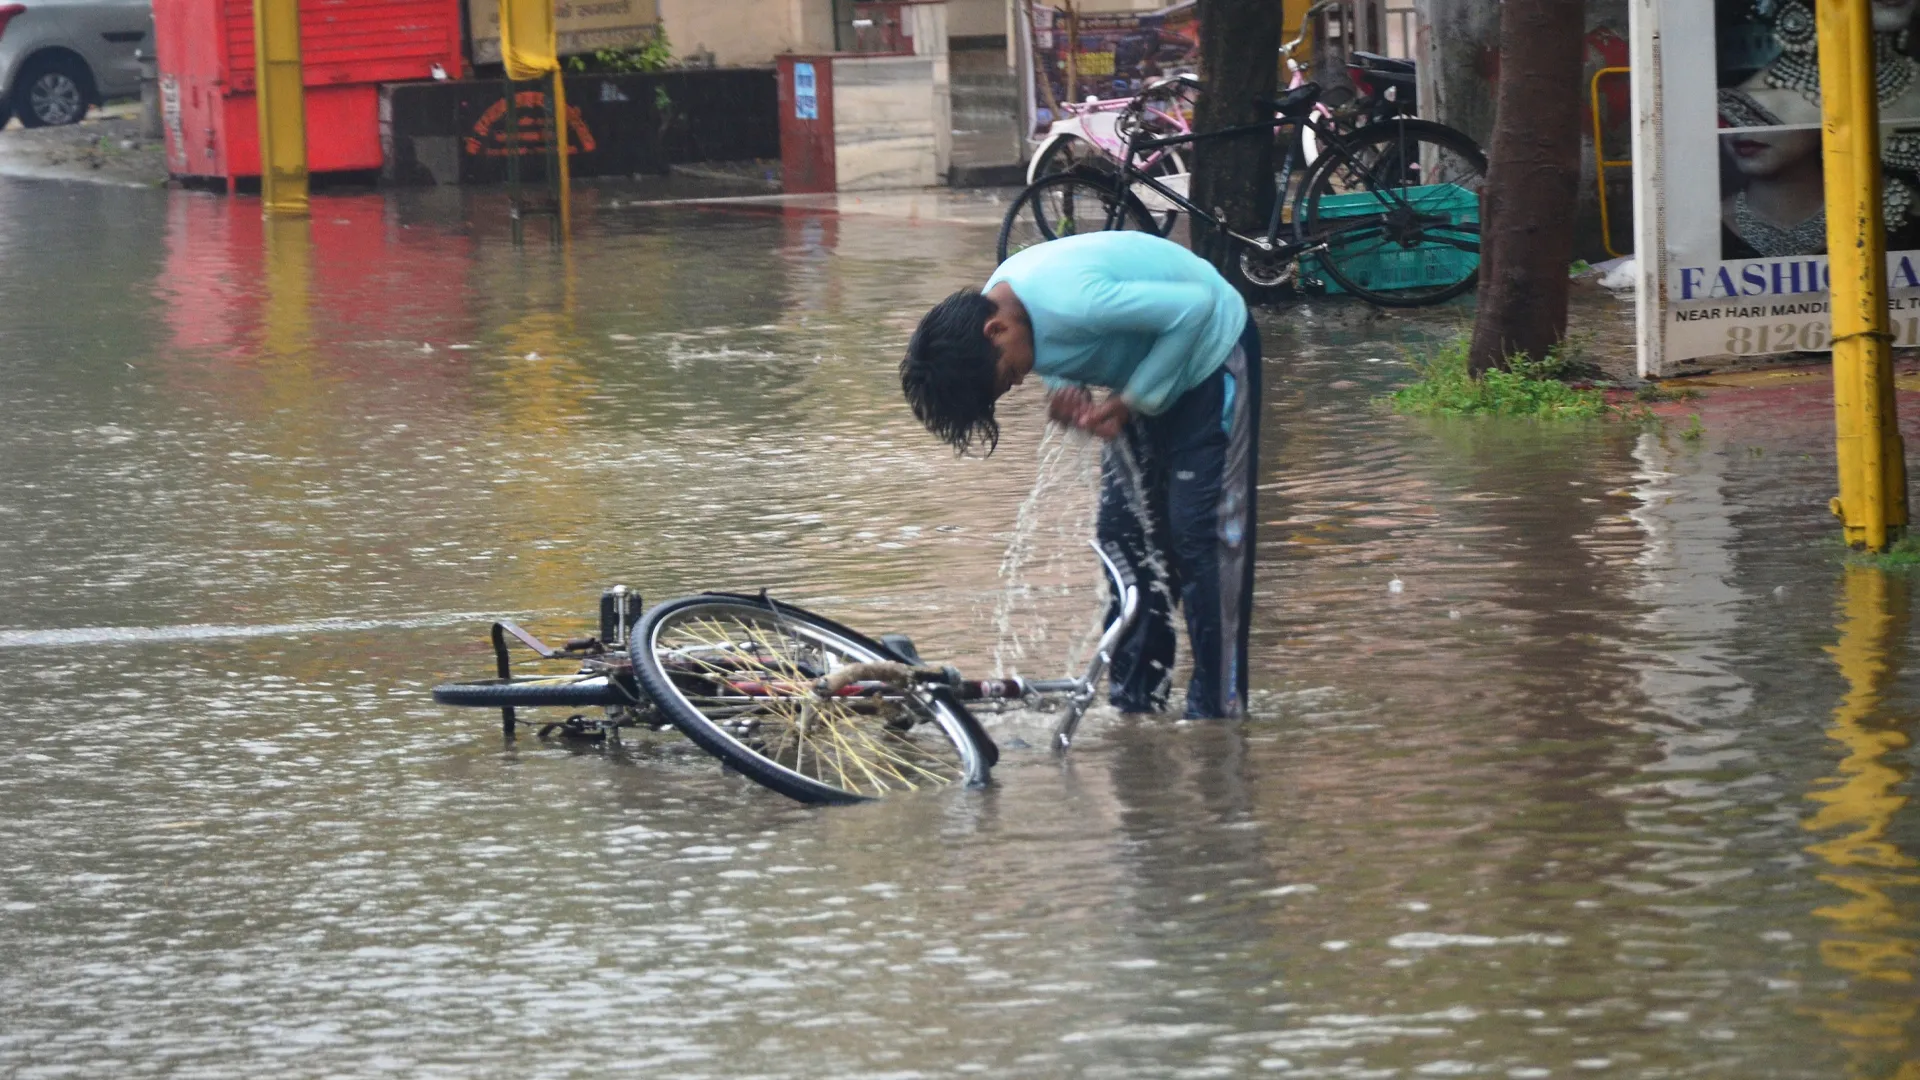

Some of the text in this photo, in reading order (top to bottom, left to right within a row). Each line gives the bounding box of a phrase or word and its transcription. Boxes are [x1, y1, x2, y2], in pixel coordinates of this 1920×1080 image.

[1679, 260, 1829, 300] FASHI
[1675, 307, 1721, 322] NEAR
[1725, 306, 1767, 318] HARI
[1725, 322, 1832, 354] 8126
